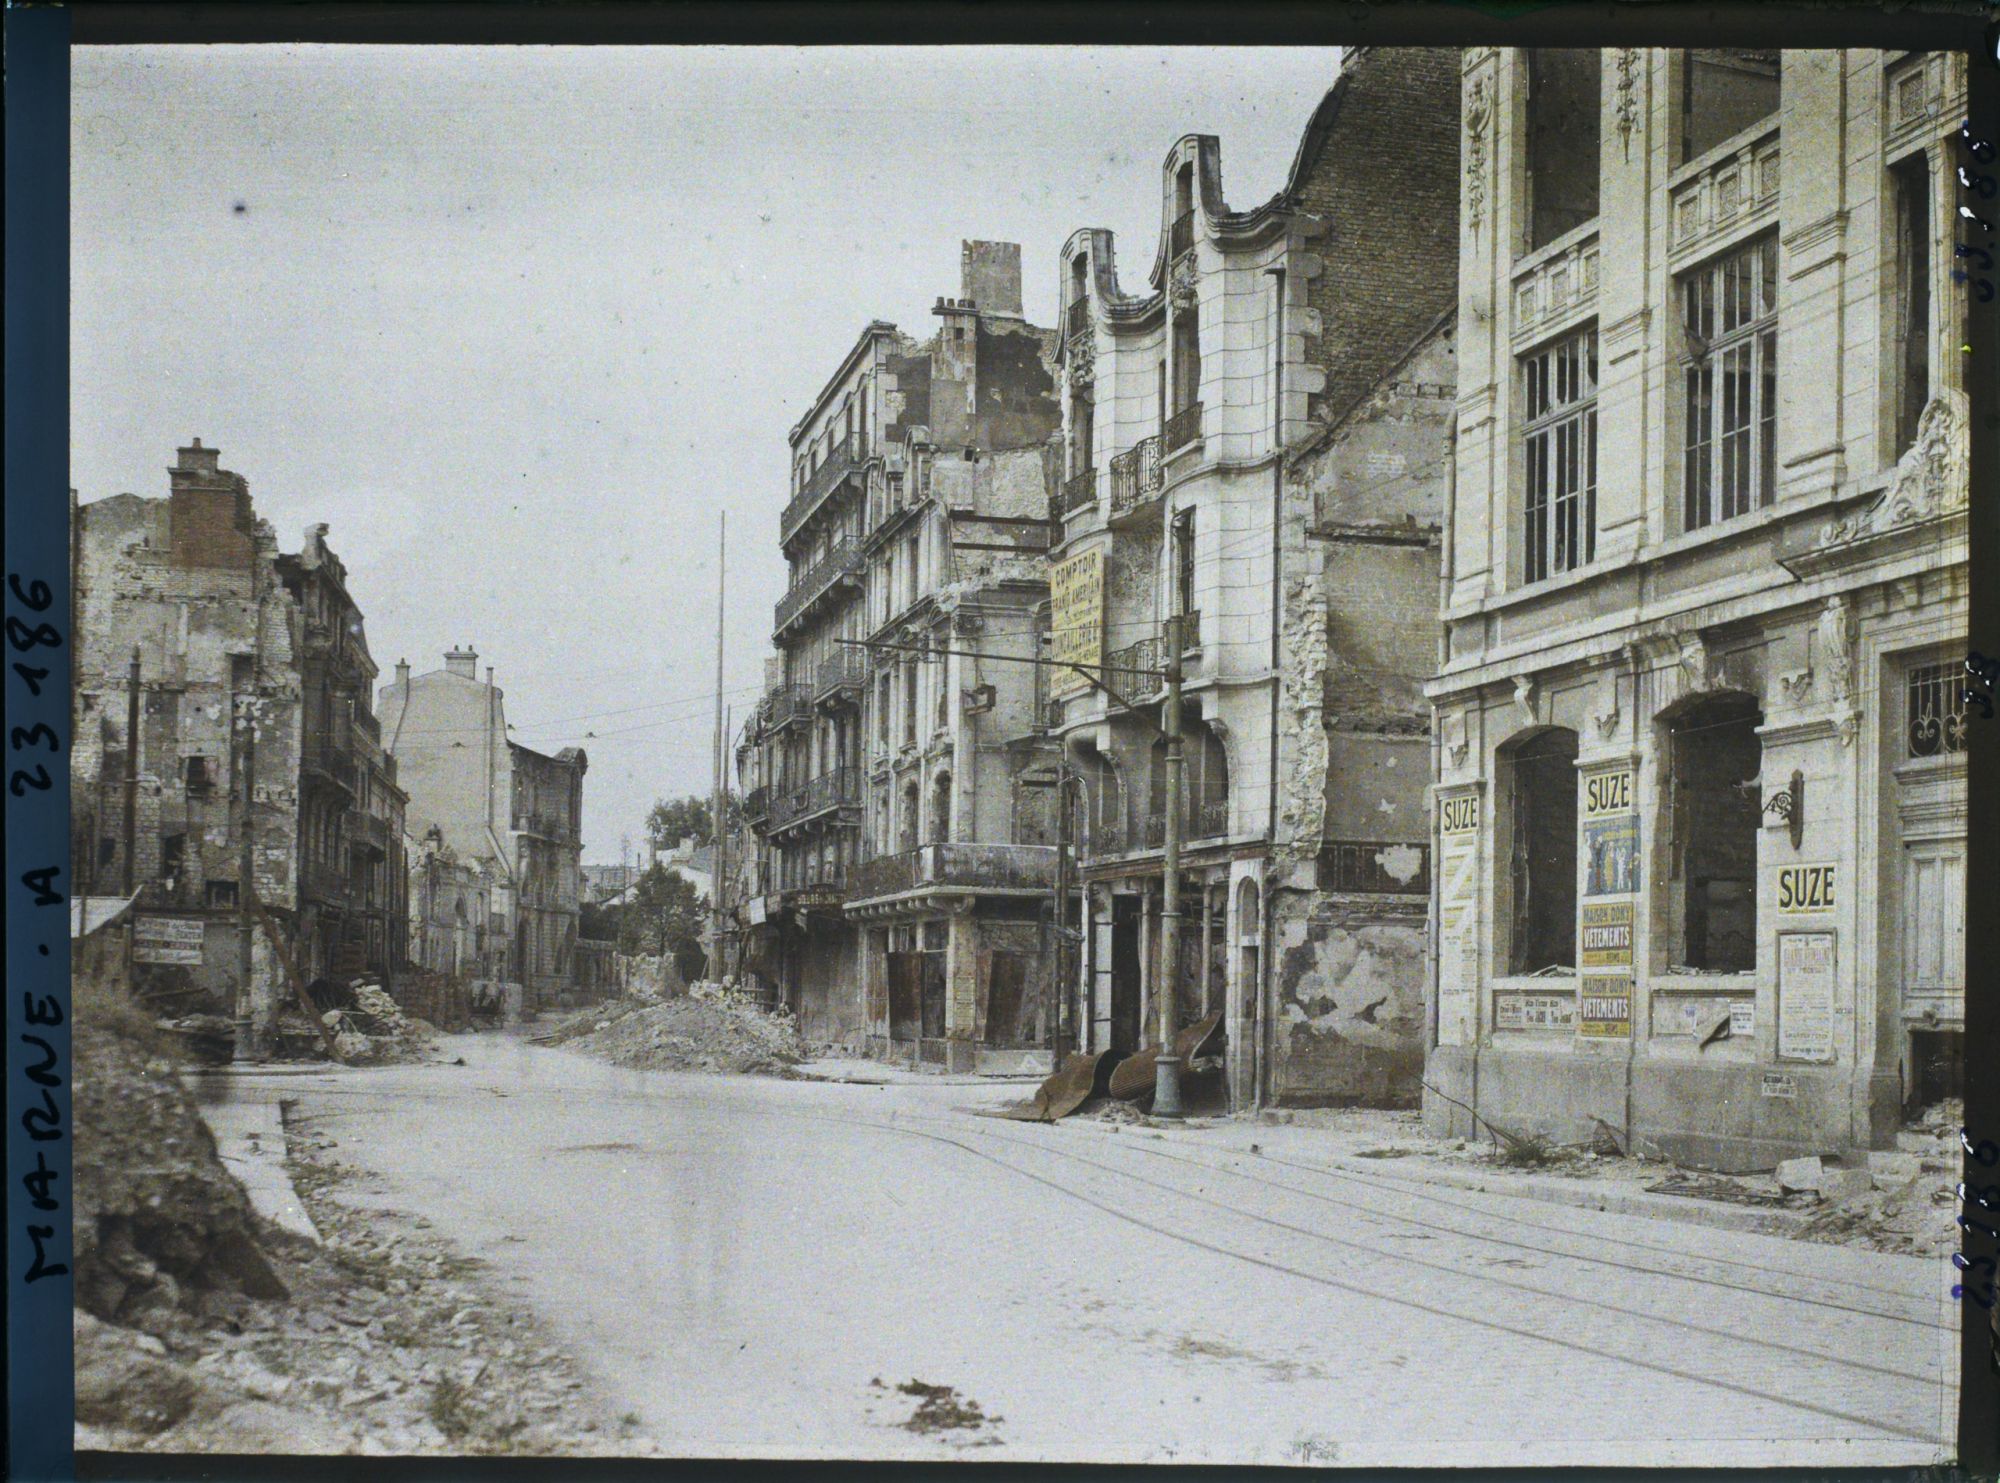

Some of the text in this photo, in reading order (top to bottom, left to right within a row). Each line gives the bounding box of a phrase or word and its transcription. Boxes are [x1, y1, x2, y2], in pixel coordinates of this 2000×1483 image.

[1055, 551, 1096, 587] COMPTOIR
[1588, 773, 1629, 813] SUZE
[1444, 797, 1477, 832] SUZE
[21, 865, 65, 906] A
[1780, 866, 1834, 909] SUZE
[21, 991, 69, 1284] MARNE
